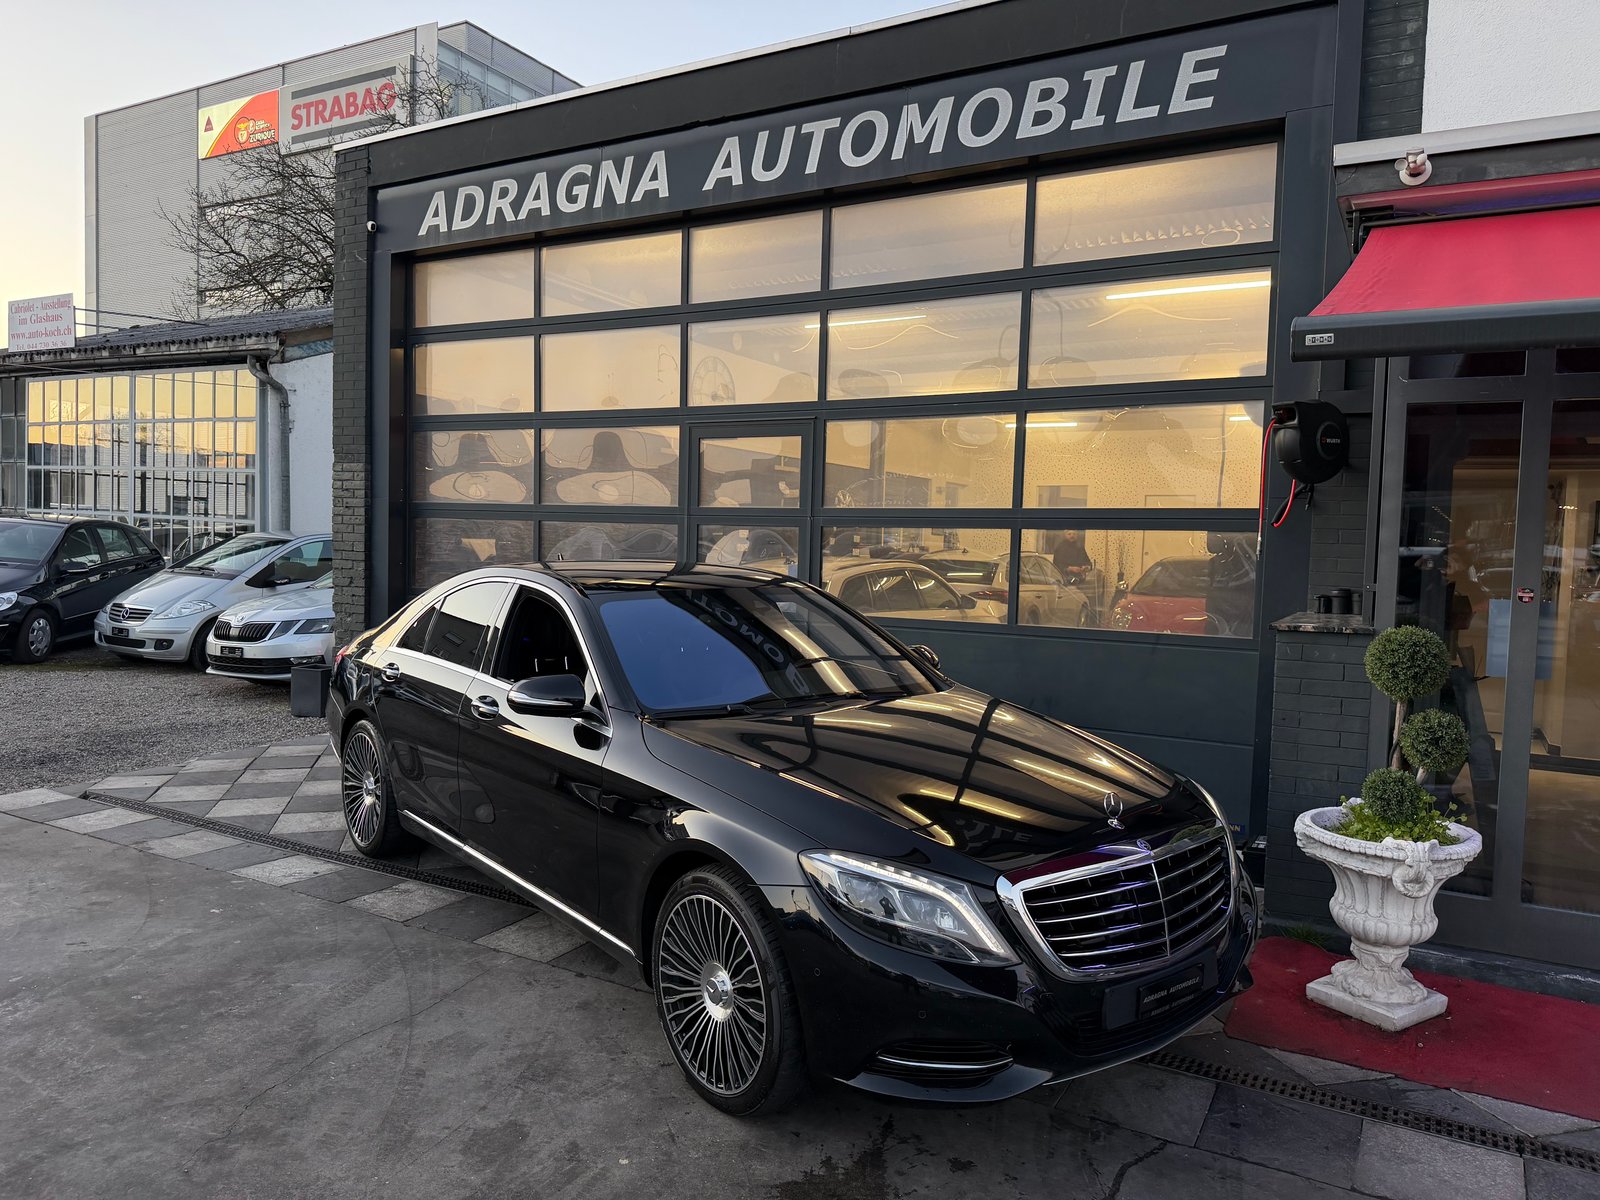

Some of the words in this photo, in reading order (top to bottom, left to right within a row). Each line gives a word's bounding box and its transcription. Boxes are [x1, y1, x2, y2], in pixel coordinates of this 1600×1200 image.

[290, 82, 397, 131] STRABAG
[419, 149, 670, 237] ADRAGNA
[702, 43, 1228, 191] AUTOMOBILE
[11, 301, 35, 314] Cabriolet
[40, 298, 71, 310] Ausstellung
[18, 315, 27, 325] im
[30, 312, 63, 324] Glashaus
[10, 325, 72, 340] www.auto-koch.ch
